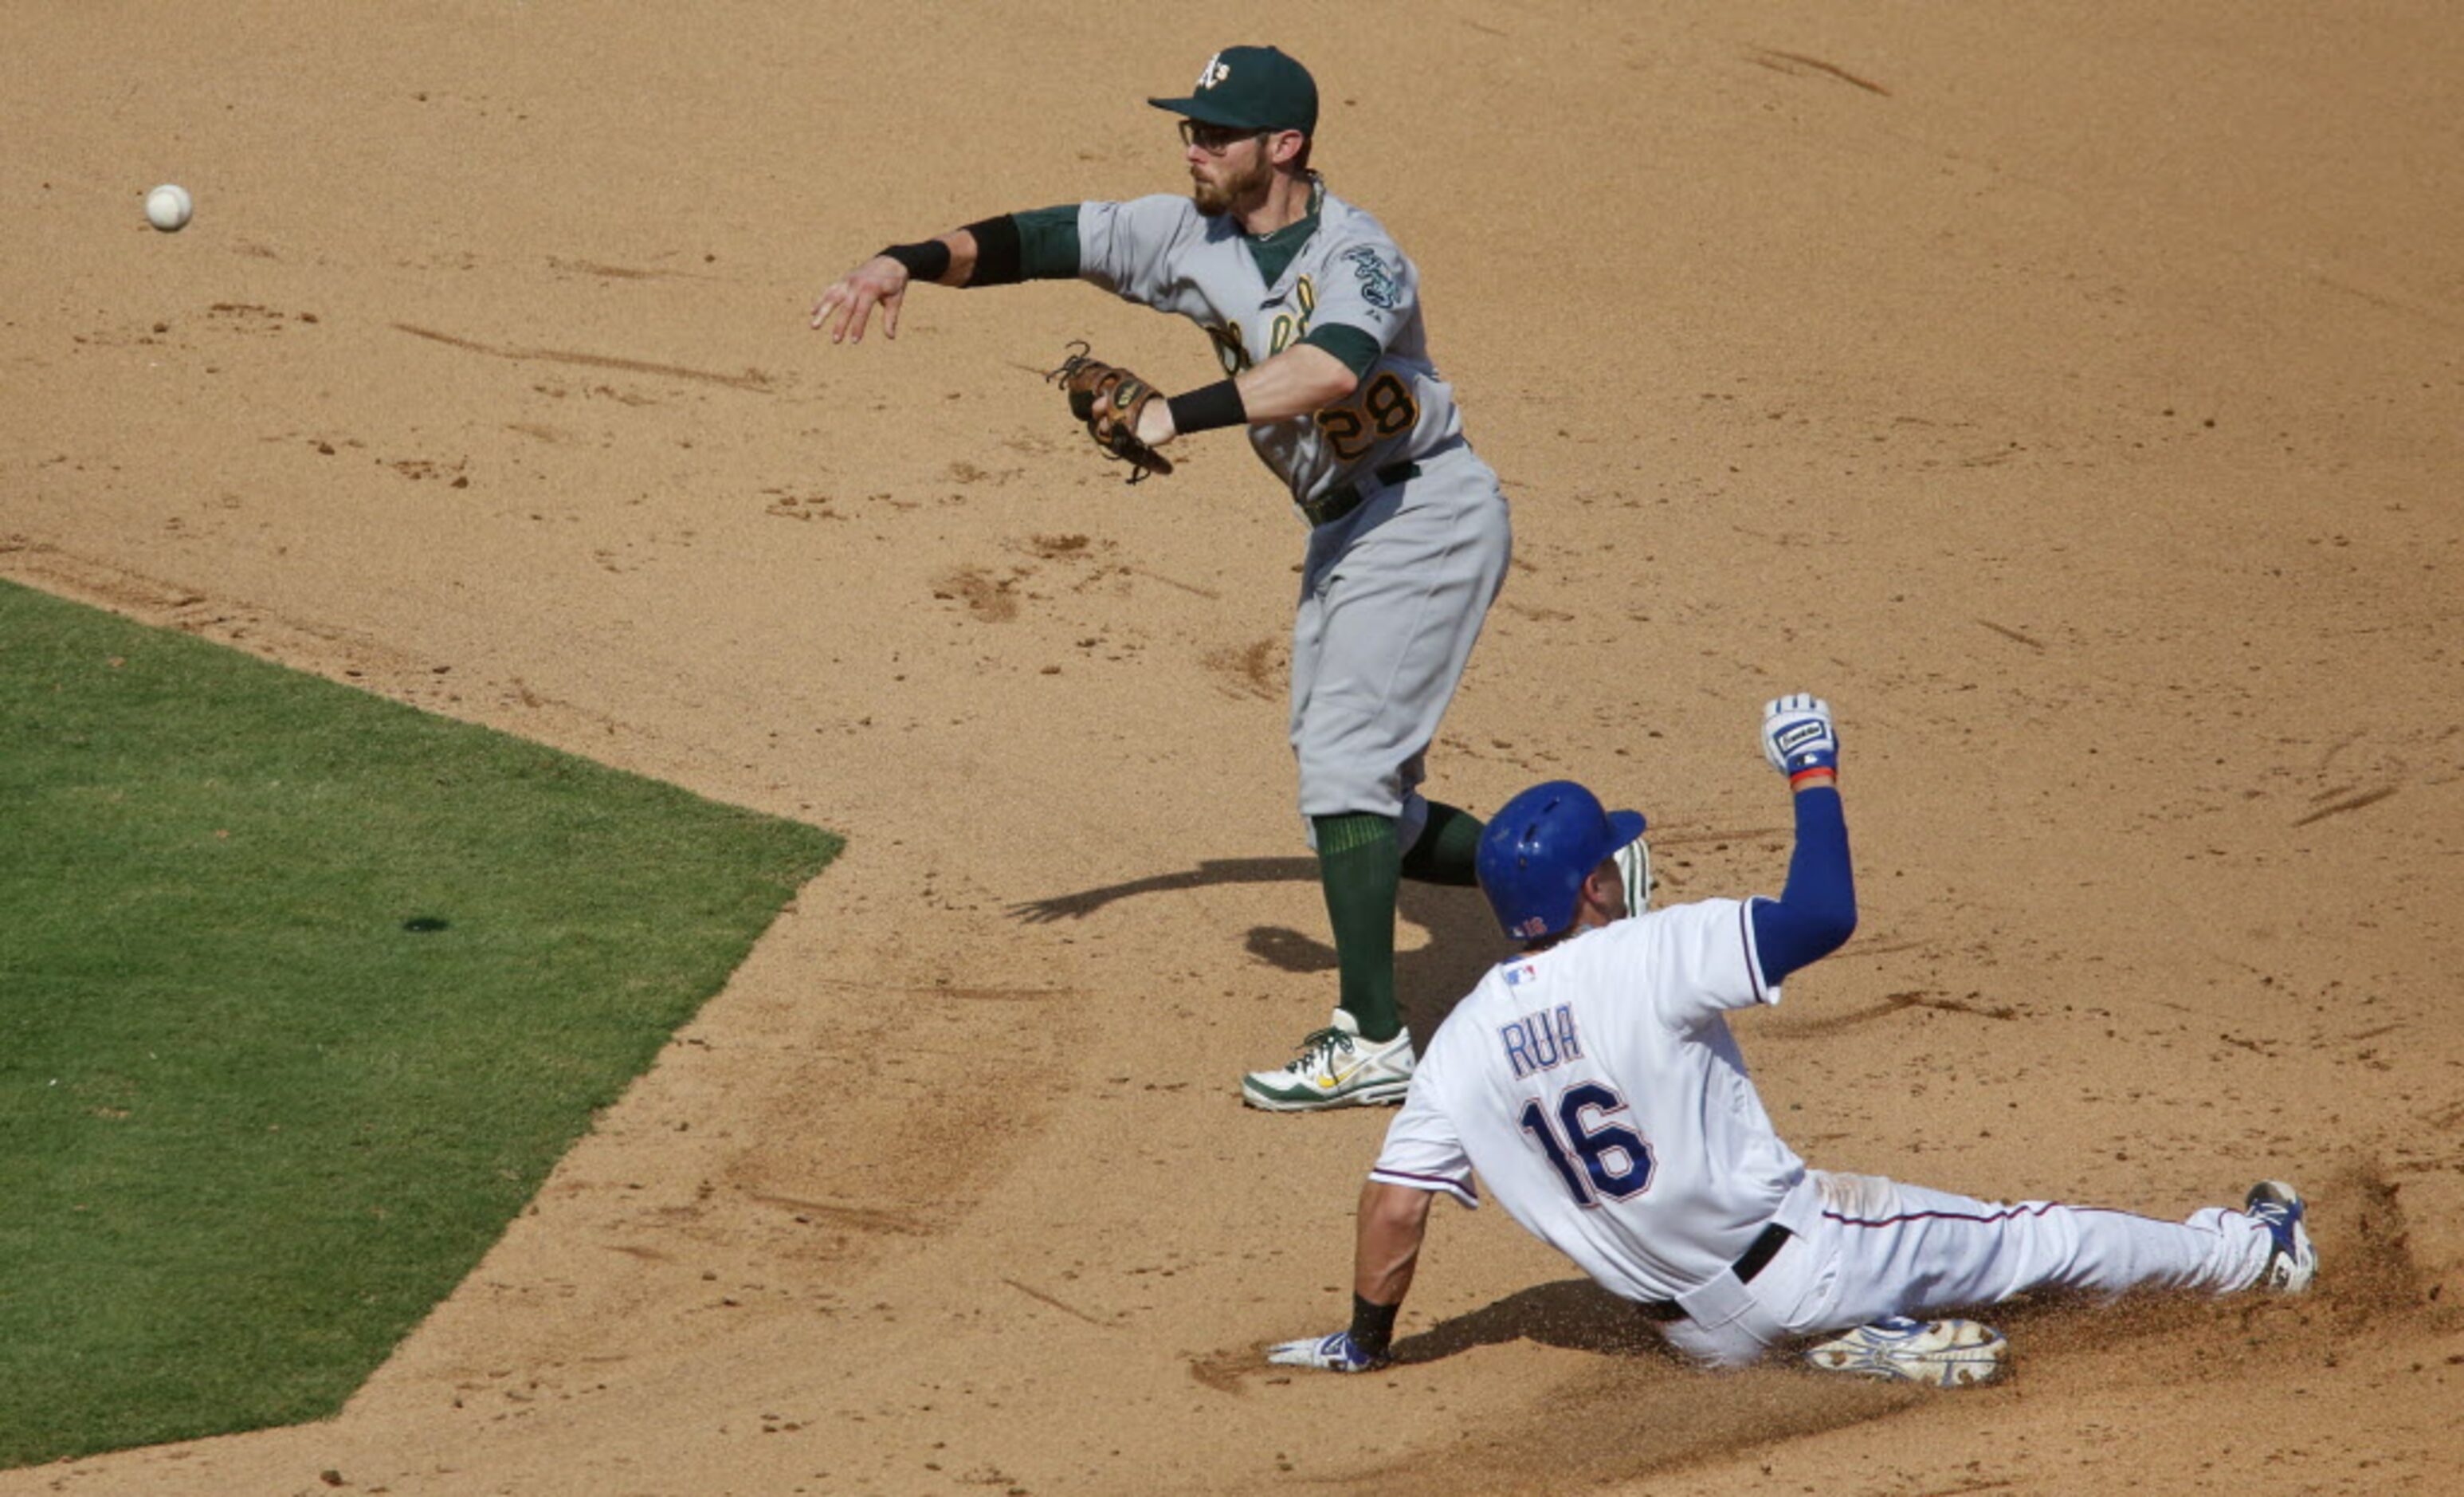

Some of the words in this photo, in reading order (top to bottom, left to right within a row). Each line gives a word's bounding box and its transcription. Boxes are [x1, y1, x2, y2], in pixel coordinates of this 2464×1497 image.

[1197, 52, 1230, 88] A's
[1313, 371, 1419, 461] 28
[1498, 1002, 1584, 1081] RUA
[1517, 1079, 1658, 1208] 16
